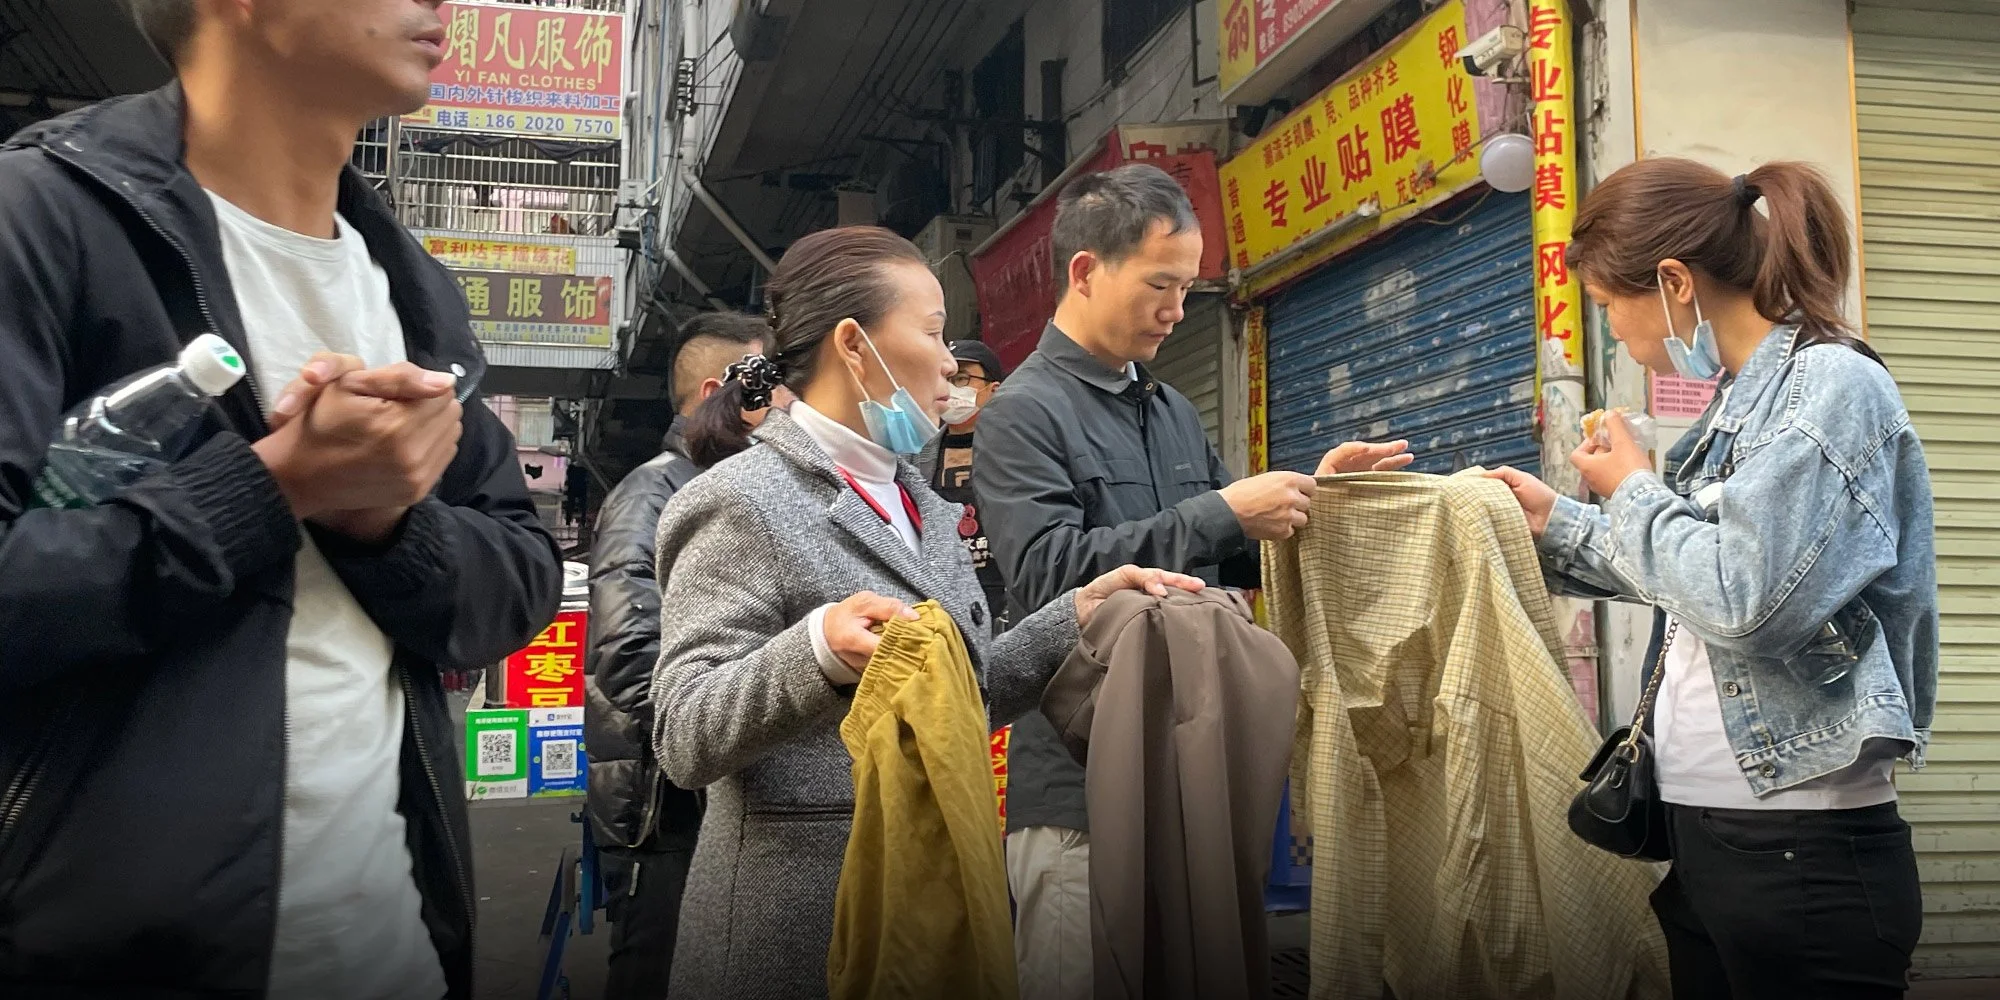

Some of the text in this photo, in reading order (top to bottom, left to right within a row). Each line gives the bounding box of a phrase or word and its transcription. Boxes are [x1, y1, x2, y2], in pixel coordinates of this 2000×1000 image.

[443, 6, 612, 83] 熠凡服饰
[455, 70, 596, 91] YI FAN CLOTHES
[486, 113, 515, 129] 186
[525, 115, 565, 131] 2020
[575, 118, 613, 134] 7570
[1439, 26, 1475, 165] 钢化膜
[1263, 93, 1421, 229] 专业贴膜
